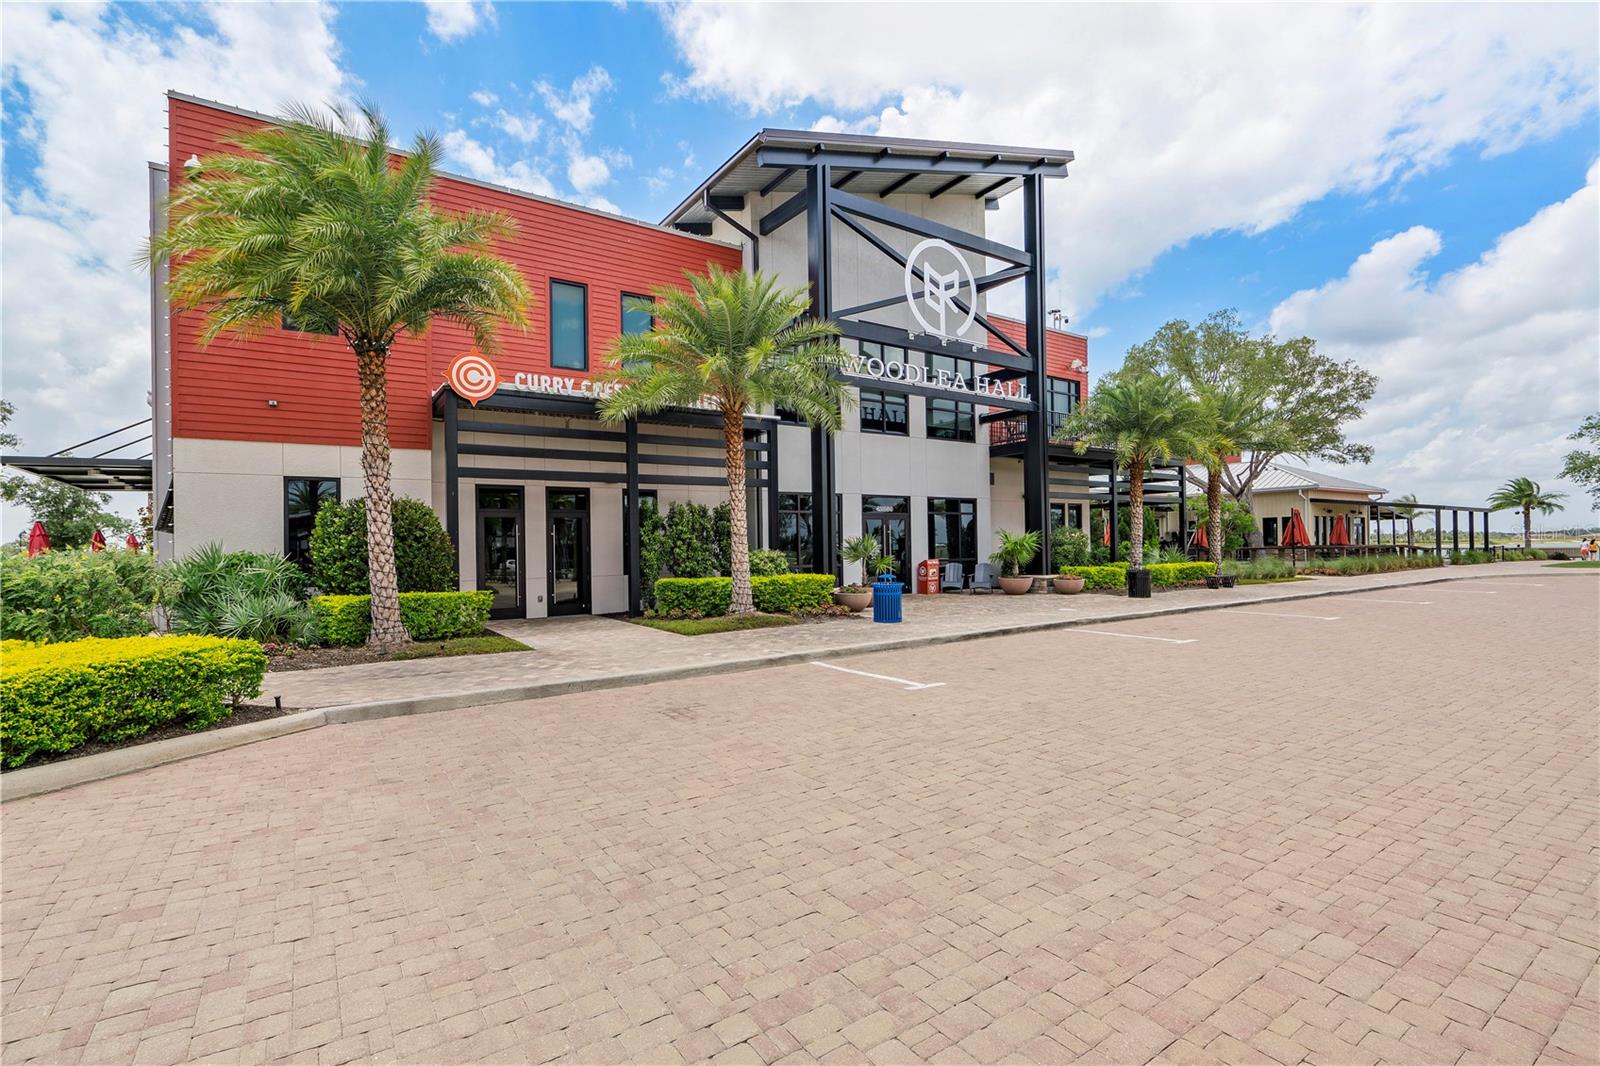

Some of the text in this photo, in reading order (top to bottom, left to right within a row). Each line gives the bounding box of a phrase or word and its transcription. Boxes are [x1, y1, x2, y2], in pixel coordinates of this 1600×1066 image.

[514, 372, 575, 396] CURRY
[841, 352, 1031, 401] WOODLEA HALL
